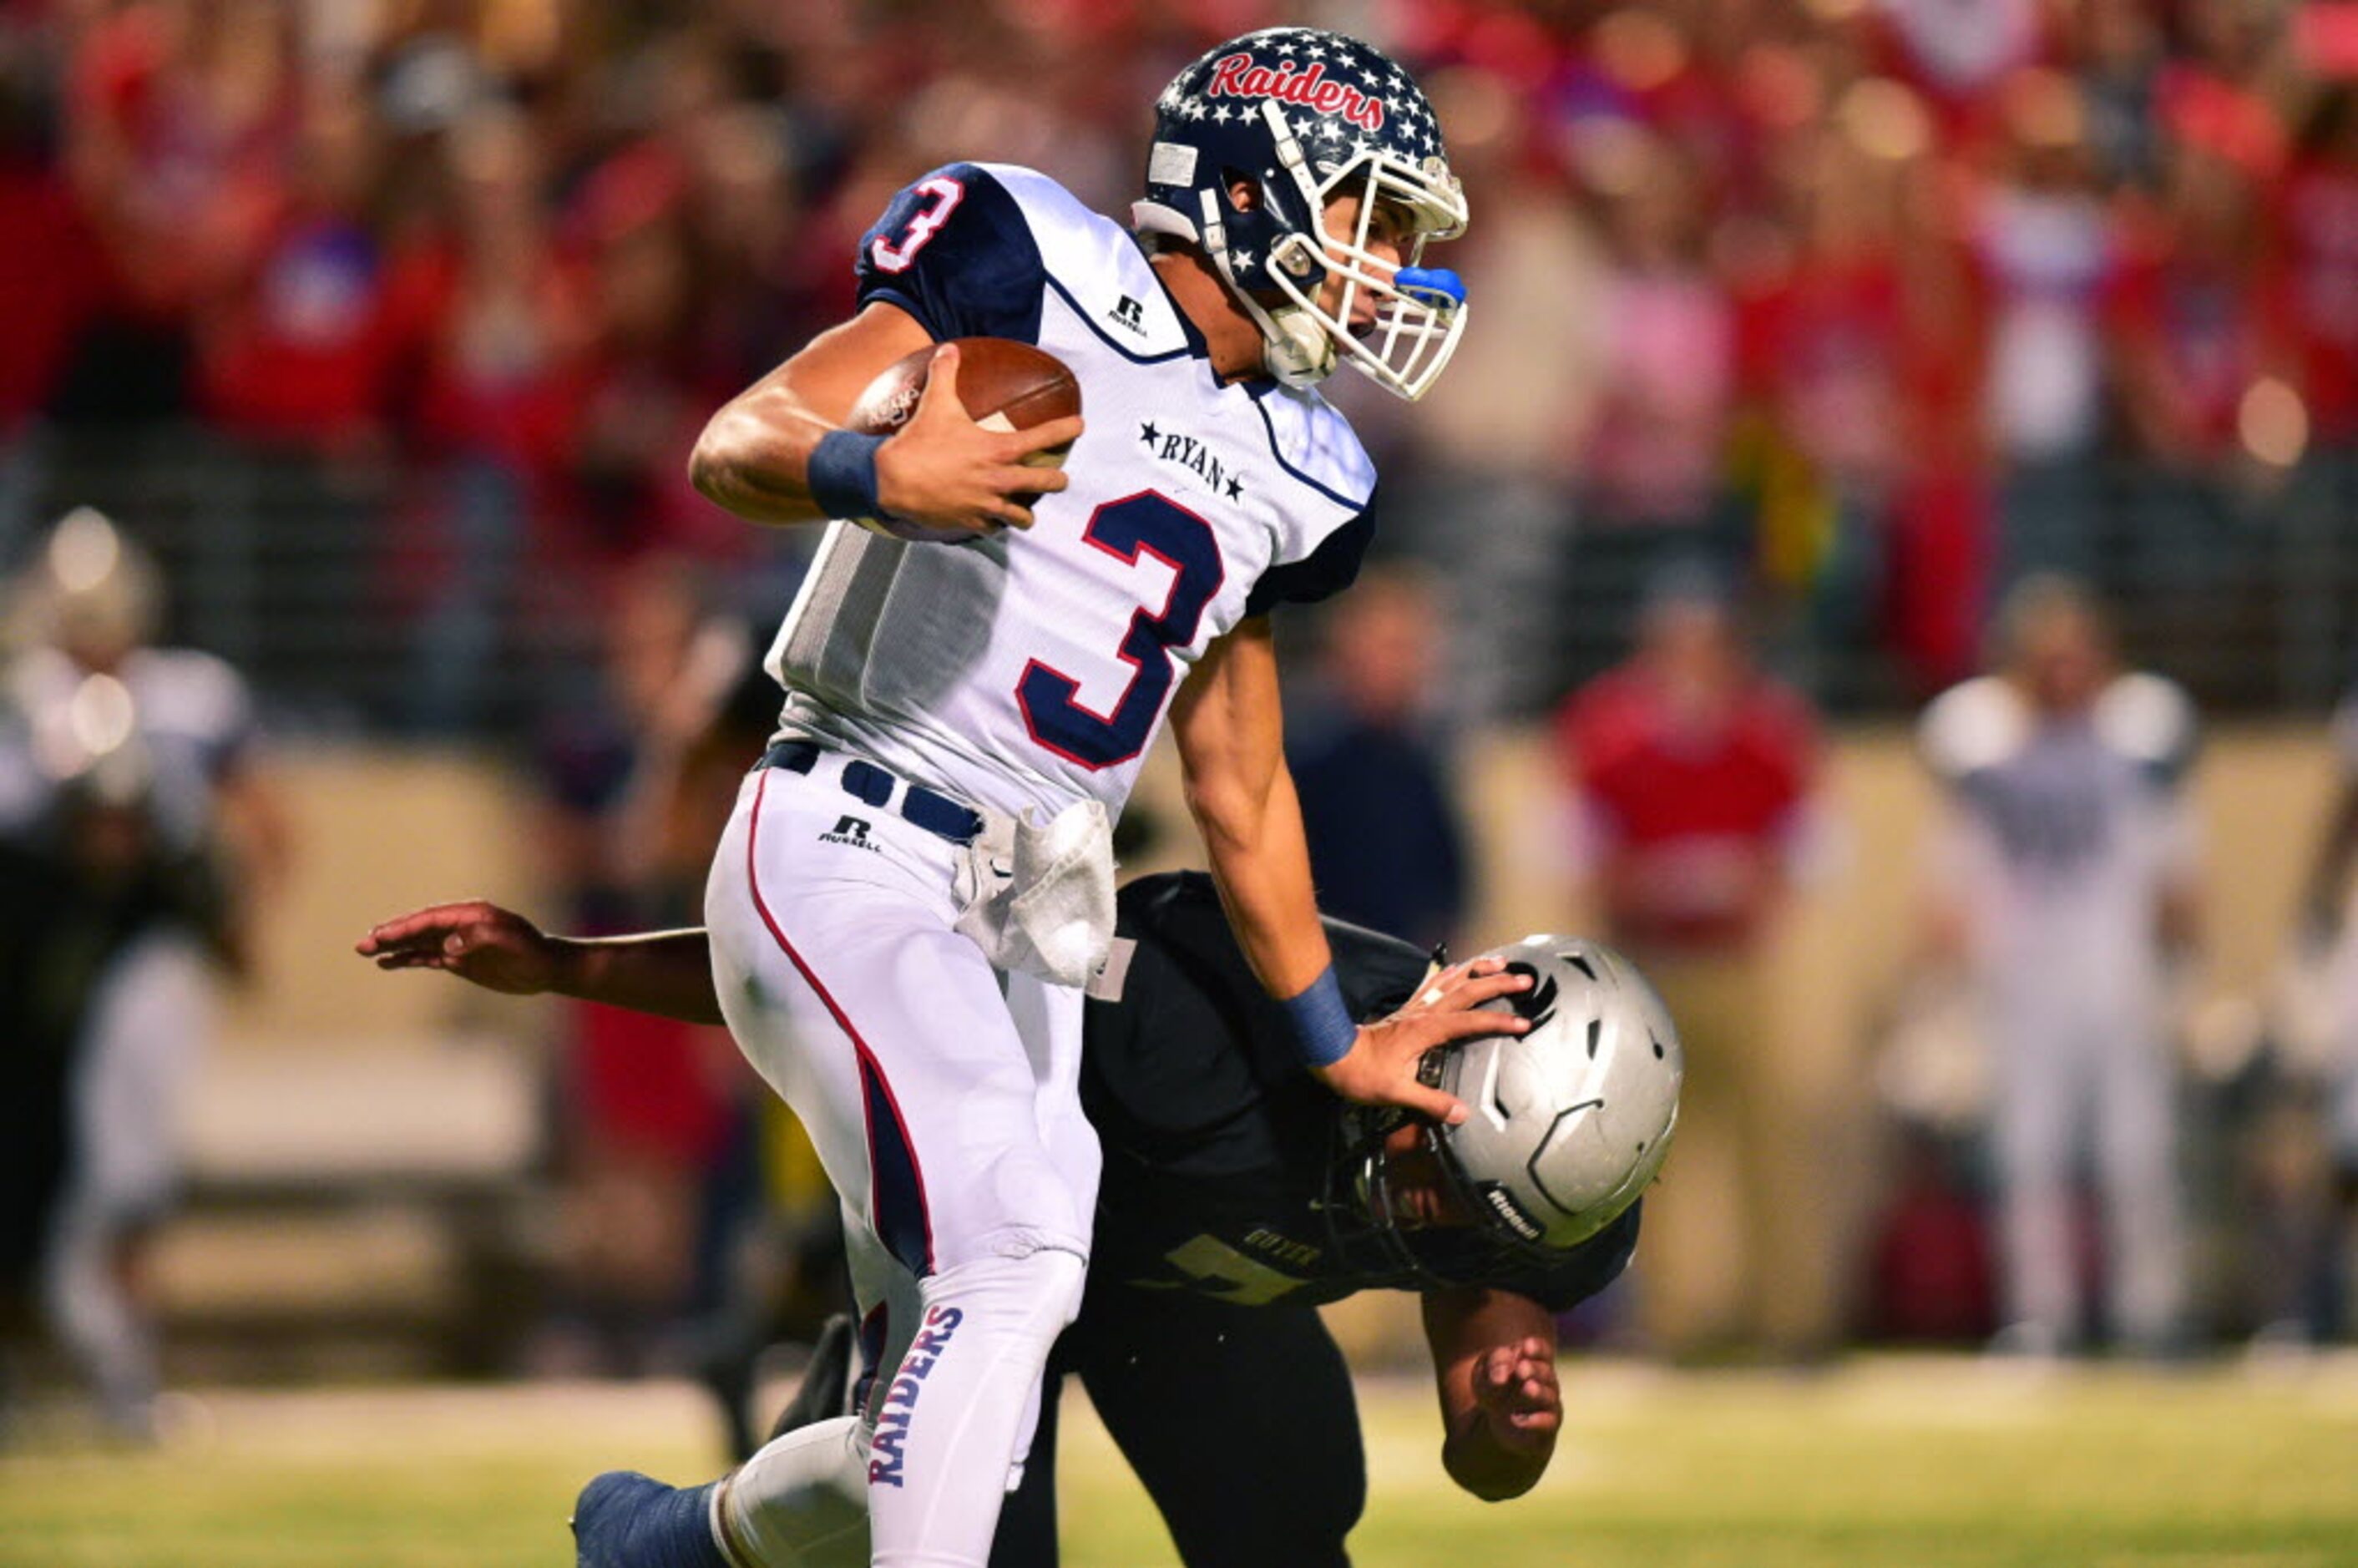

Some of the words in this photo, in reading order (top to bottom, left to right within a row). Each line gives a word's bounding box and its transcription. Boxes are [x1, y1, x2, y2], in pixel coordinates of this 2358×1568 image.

[1208, 53, 1384, 132] Raiders
[871, 175, 965, 275] 3
[1158, 433, 1225, 493] RYAN
[1015, 488, 1225, 772] 3
[817, 833, 882, 852] RUSSELL
[868, 1305, 963, 1488] RAIDERS
